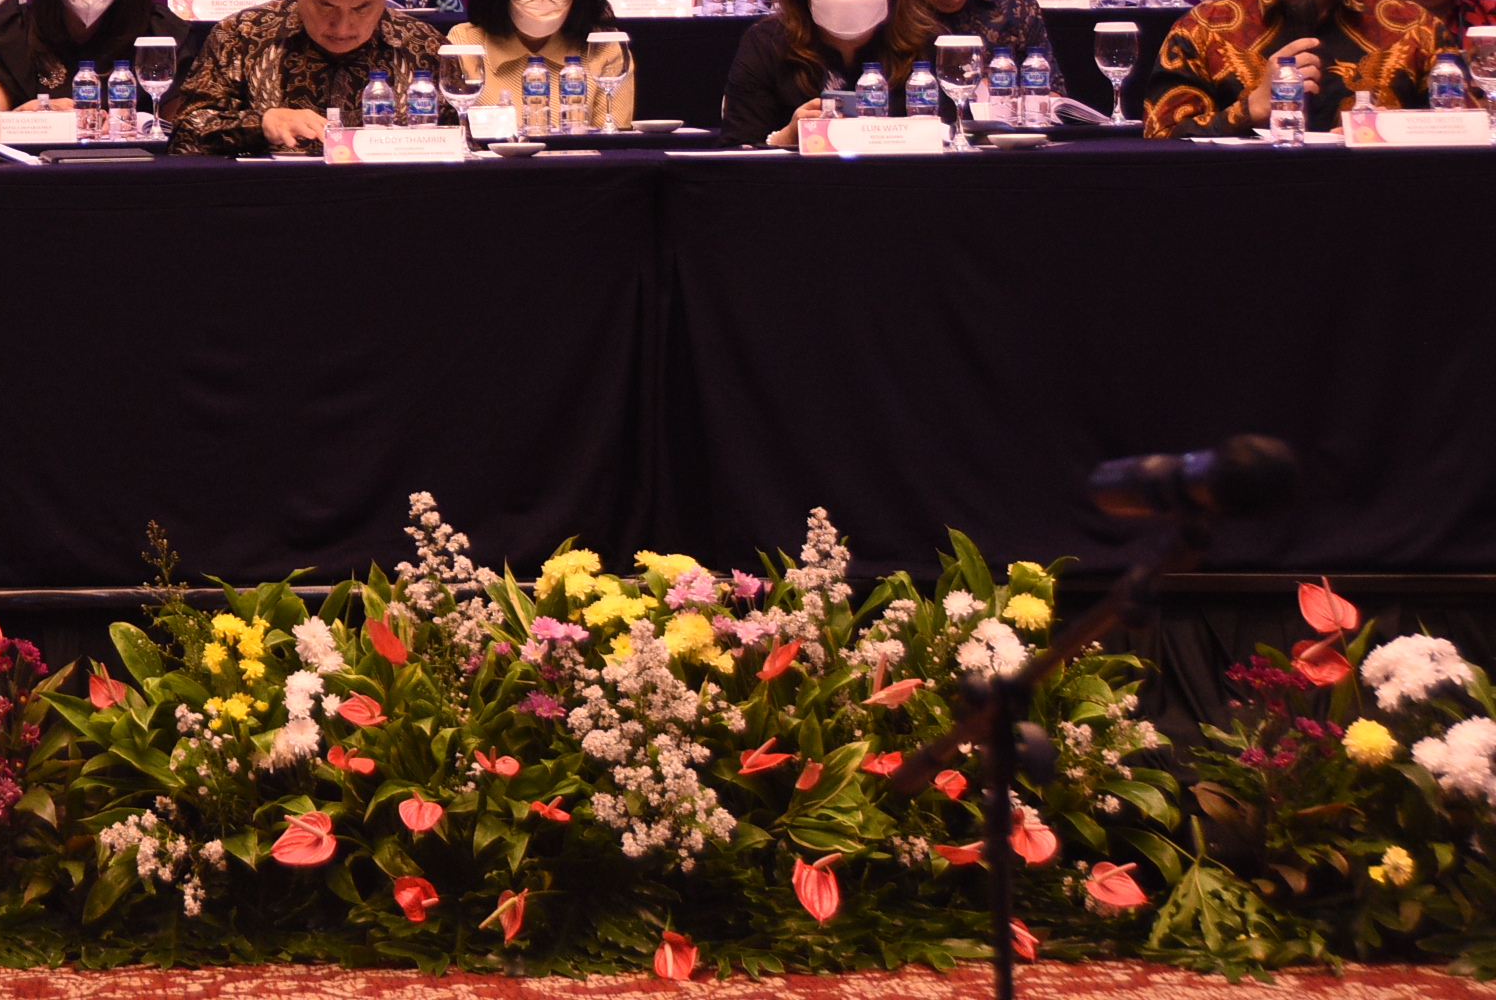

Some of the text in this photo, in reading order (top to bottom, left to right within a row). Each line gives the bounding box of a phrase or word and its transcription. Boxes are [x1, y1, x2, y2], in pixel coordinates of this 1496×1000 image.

[861, 124, 880, 132] ELIN
[369, 136, 446, 144] FREDDY THAMRIN
